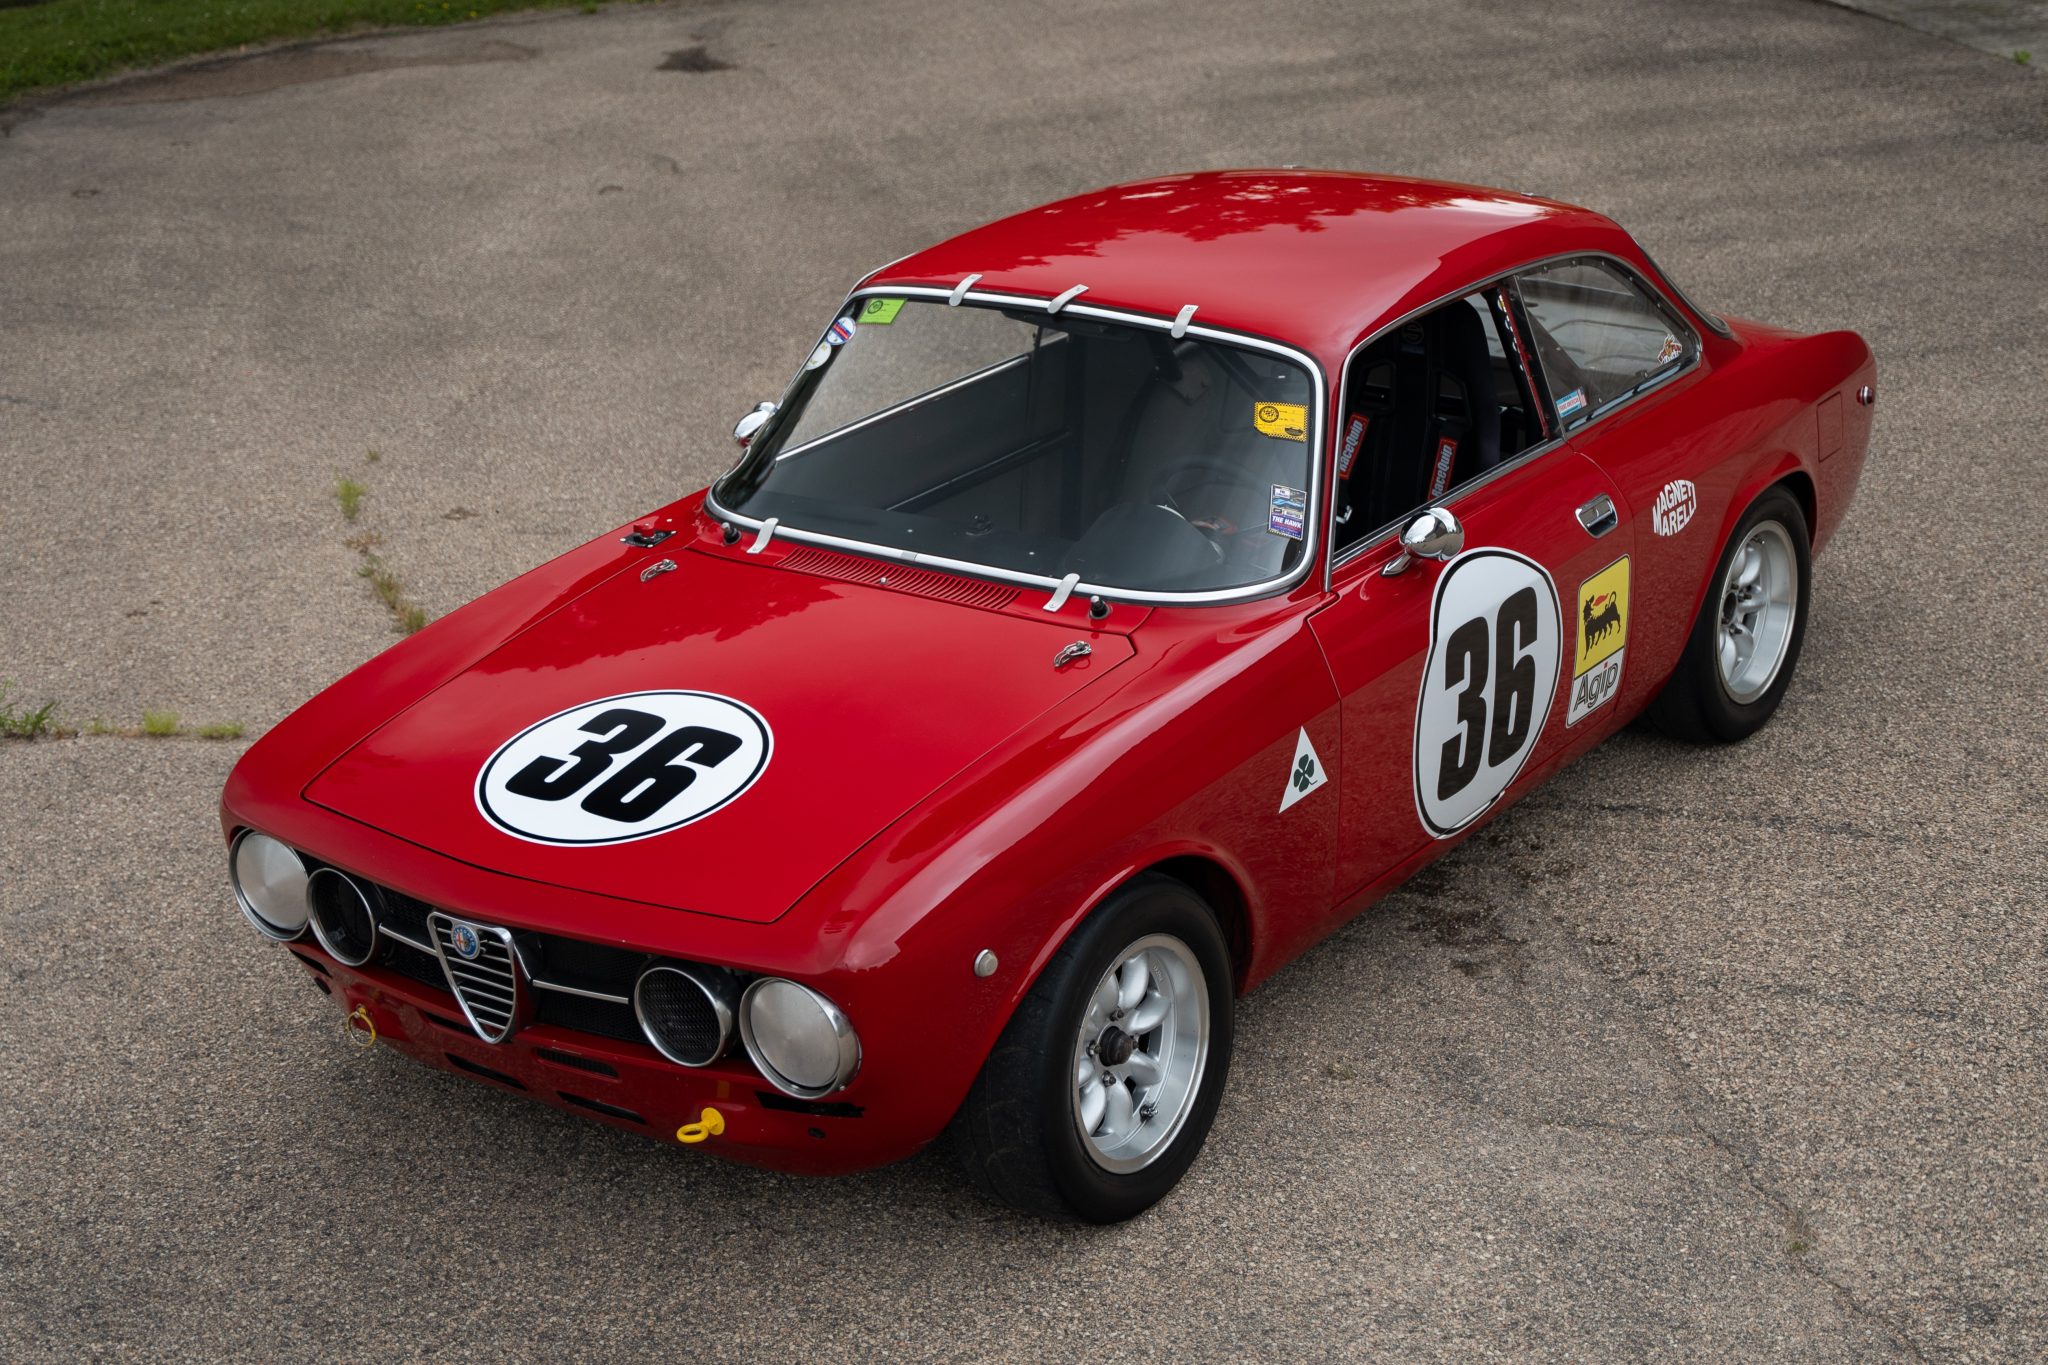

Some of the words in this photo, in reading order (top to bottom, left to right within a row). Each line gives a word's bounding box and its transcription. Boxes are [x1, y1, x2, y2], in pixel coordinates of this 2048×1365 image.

[1432, 445, 1452, 498] RaceQuip
[1653, 480, 1697, 515] MAGNETI
[1272, 515, 1284, 523] THE
[1284, 518, 1302, 529] HAWK
[1653, 498, 1697, 536] MARELLI
[1437, 587, 1538, 802] 36
[1573, 661, 1618, 713] Agip
[505, 708, 743, 823] 36
